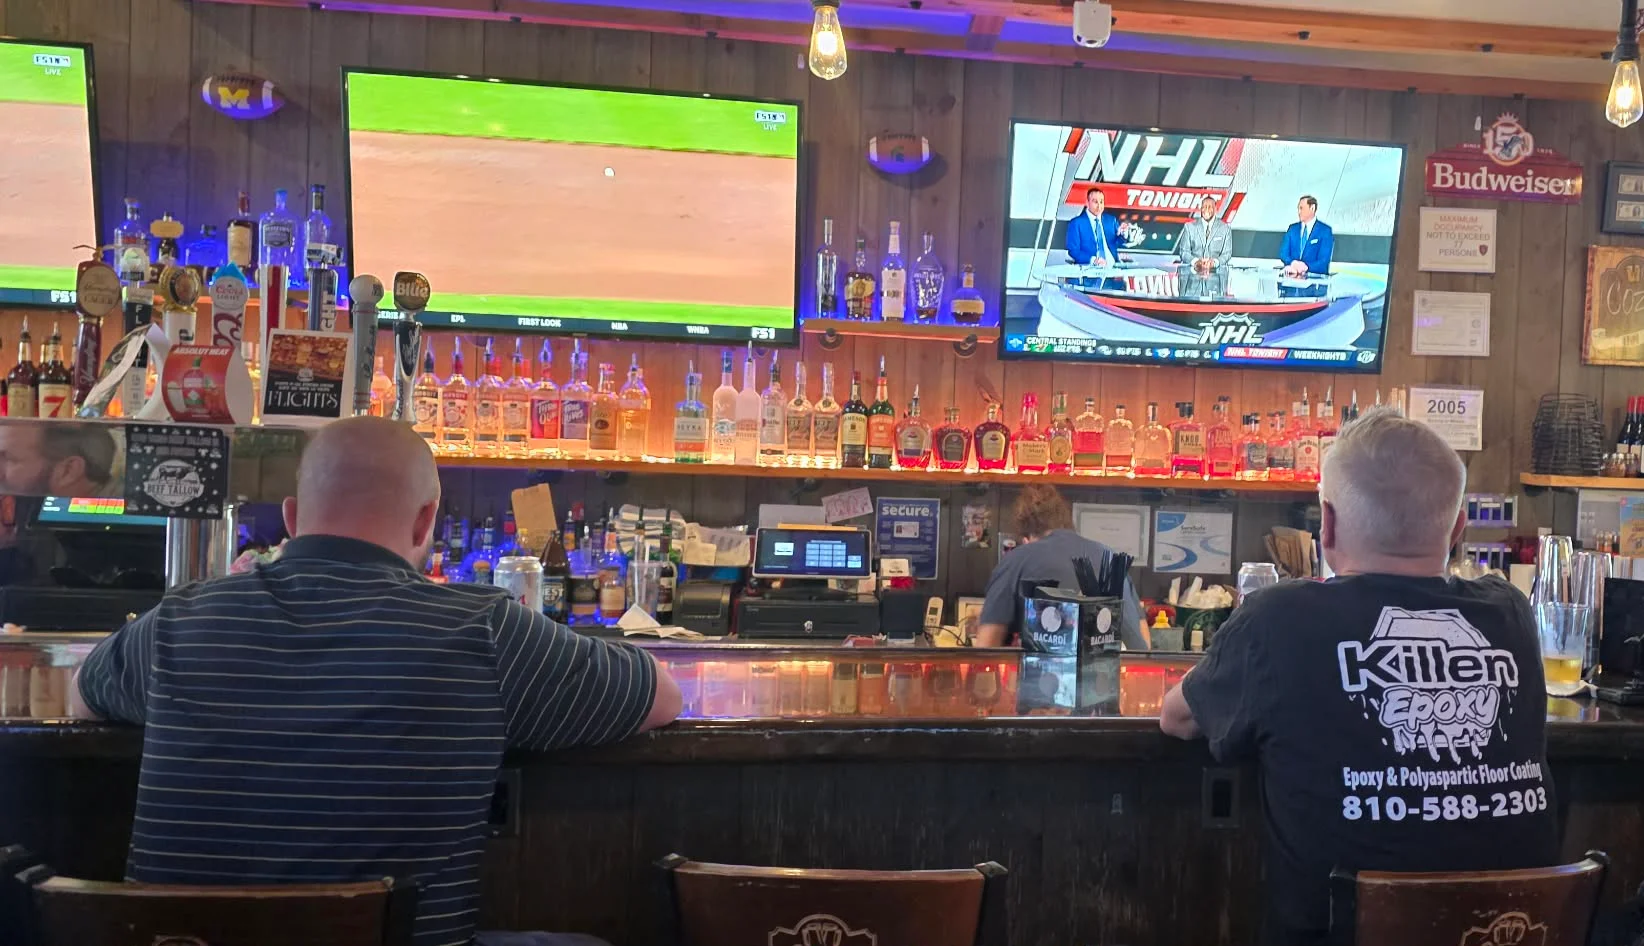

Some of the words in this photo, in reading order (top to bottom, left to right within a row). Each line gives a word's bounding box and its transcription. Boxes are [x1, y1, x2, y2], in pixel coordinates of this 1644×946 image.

[218, 86, 250, 110] M
[1074, 132, 1236, 188] NHL
[1432, 162, 1576, 196] Budweiser
[1440, 215, 1478, 223] MAXIMUM
[1433, 223, 1483, 232] OCCUPANCY
[1426, 231, 1442, 239] NOT
[1446, 232, 1456, 240] TO
[1457, 233, 1490, 241] EXCEED
[1438, 248, 1478, 257] PERSONS
[51, 290, 77, 303] FS1
[395, 281, 429, 299] Blue
[518, 317, 541, 326] FIRST
[542, 318, 562, 328] LOOK
[751, 328, 776, 340] FS1
[1026, 336, 1057, 345] CENTRAL
[1200, 325, 1263, 345] NHL
[173, 346, 208, 356] ABSOLUT
[1294, 351, 1346, 361] WEEKNIGHTS
[43, 396, 66, 418] 7
[268, 390, 338, 409] FLIGHTS
[1427, 399, 1466, 415] 2005
[1338, 640, 1519, 692] Killen
[1342, 767, 1384, 791] Epoxy
[1386, 766, 1398, 786] &
[1400, 764, 1479, 791] Polyaspartic
[1479, 763, 1509, 784] Floor
[1509, 759, 1543, 782] Coating
[1342, 786, 1548, 822] 810-588-2303
